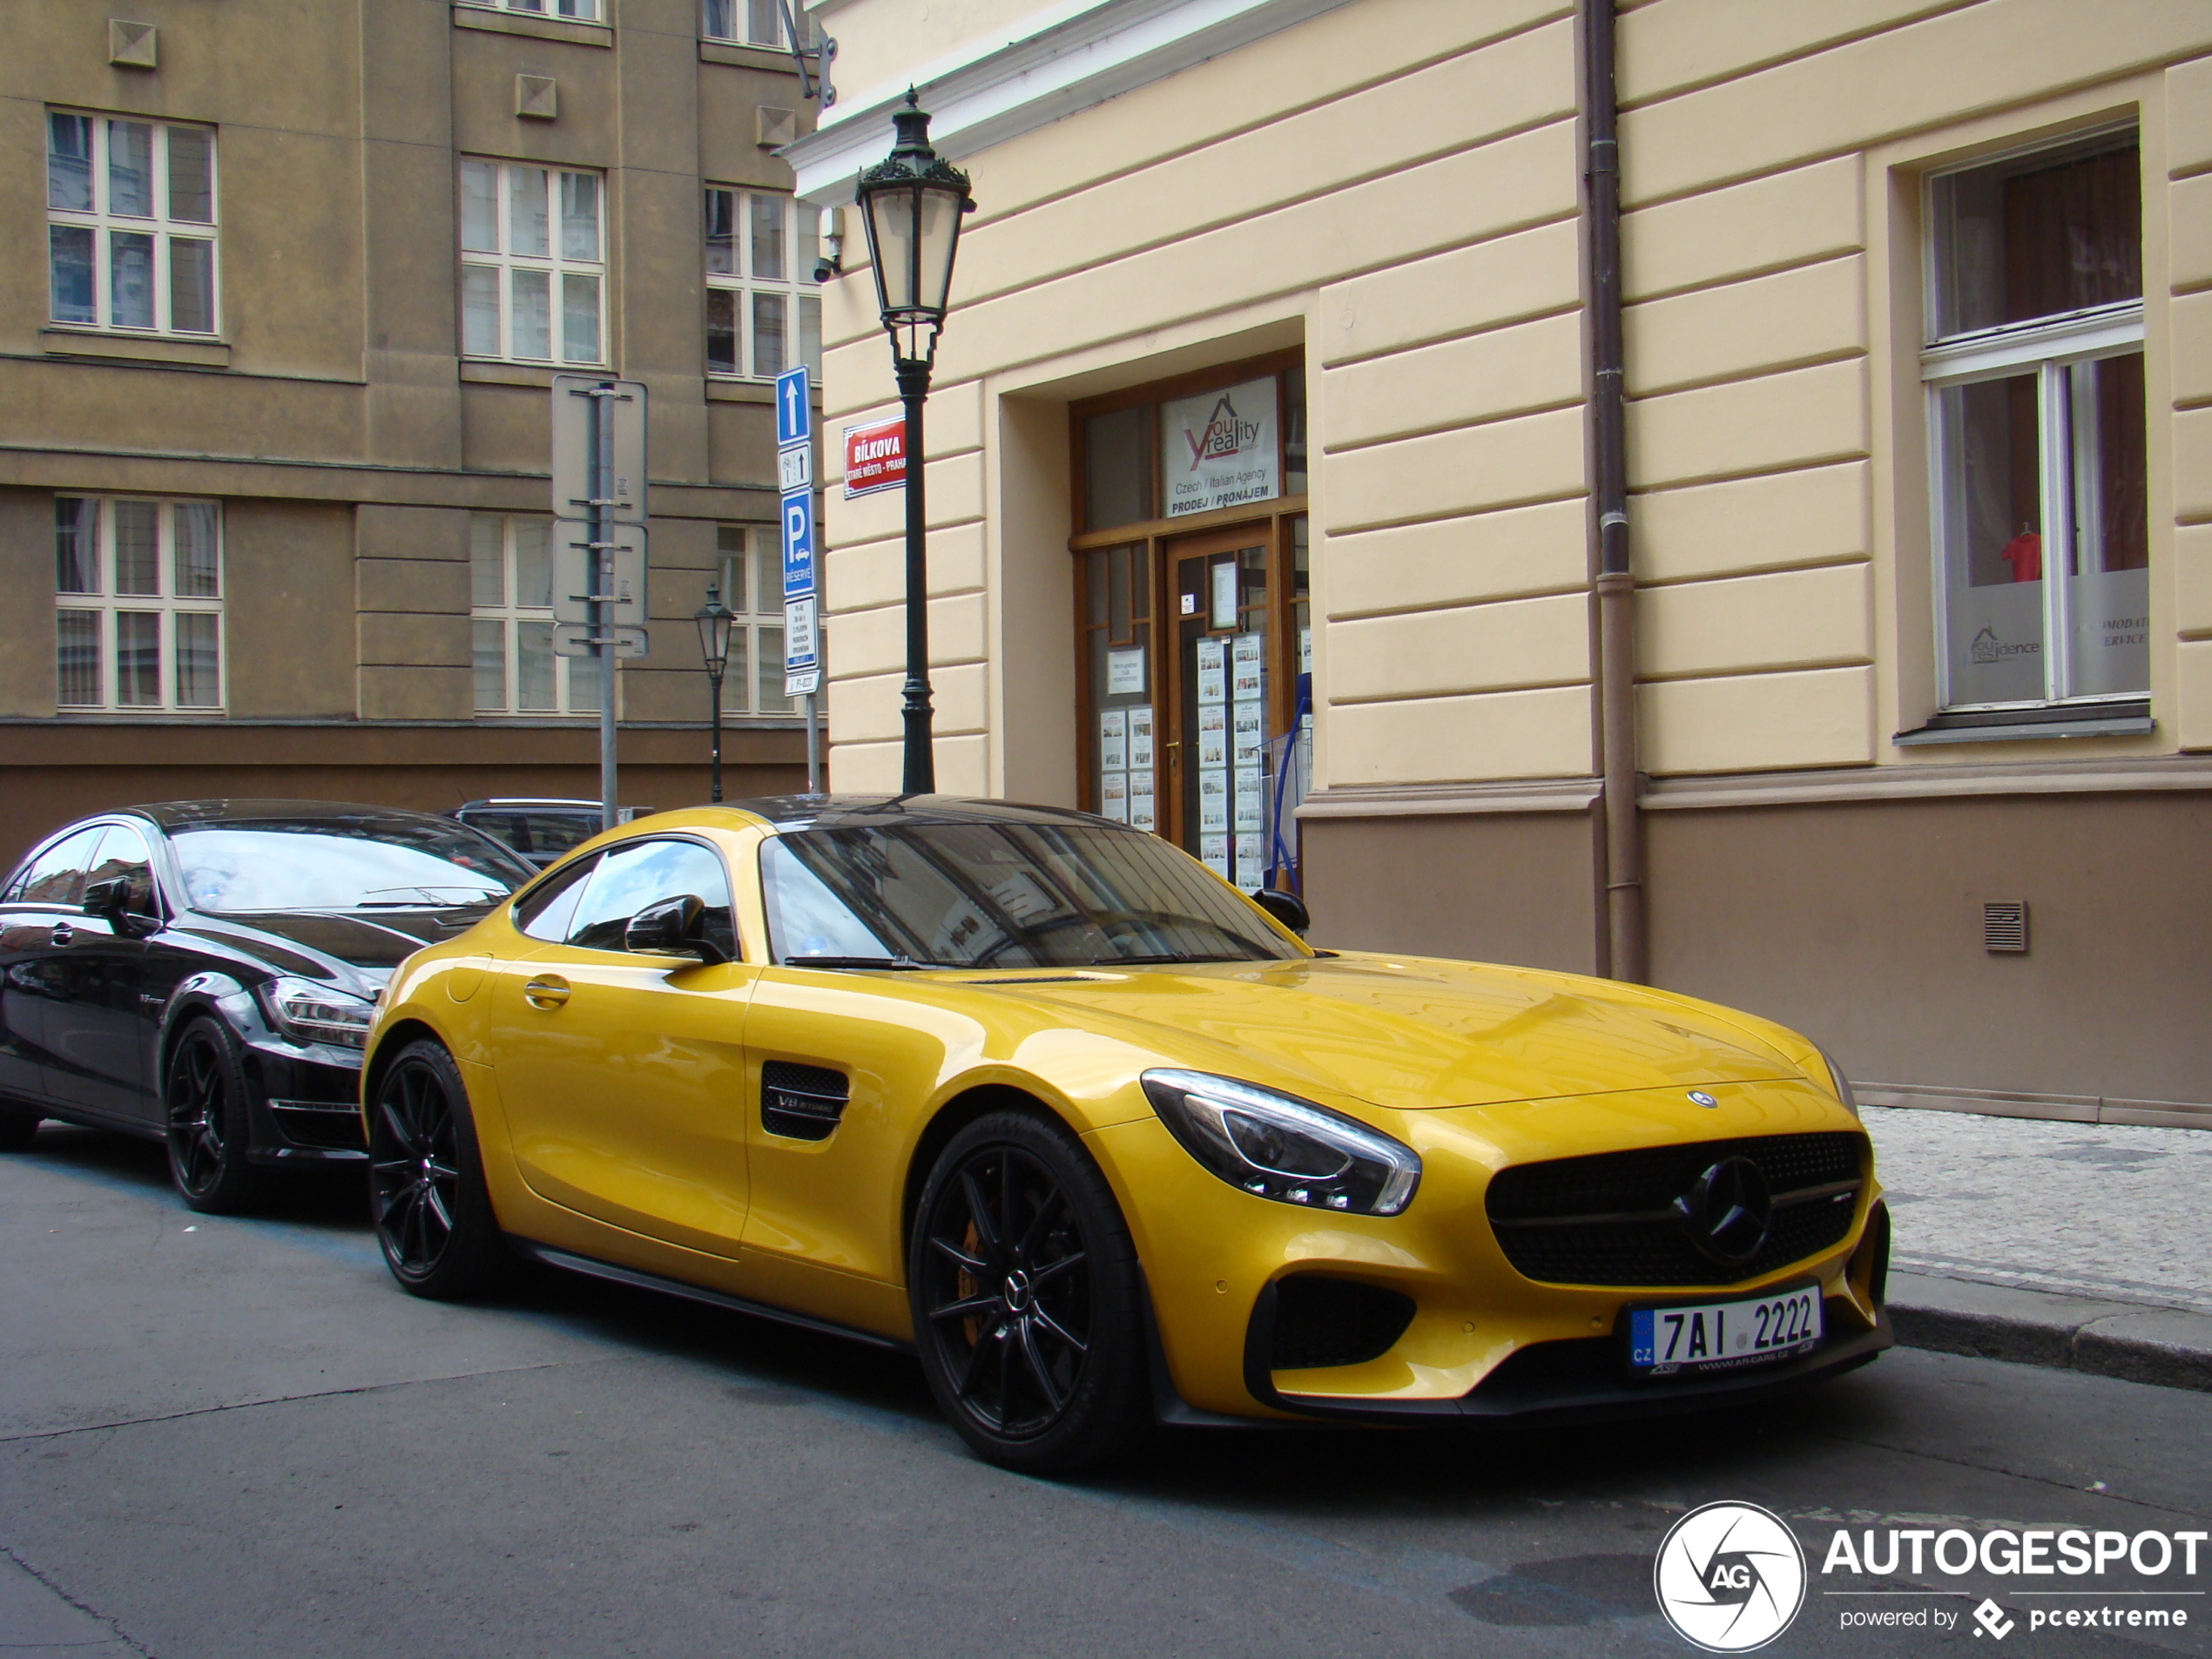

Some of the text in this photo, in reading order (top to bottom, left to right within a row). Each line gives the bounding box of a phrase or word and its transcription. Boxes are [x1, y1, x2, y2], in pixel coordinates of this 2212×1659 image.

[854, 436, 900, 463] BÍLKOVA
[847, 466, 863, 482] STARÉ
[863, 462, 882, 478] MĚSTO
[1176, 480, 1202, 495] Czech
[1210, 475, 1234, 488] Italian
[1236, 469, 1266, 484] Agency
[1172, 497, 1209, 514] PRODEJ
[1217, 486, 1269, 505] PRONÁJEM
[788, 506, 806, 563] P
[786, 564, 812, 583] RÉSERVÉ
[2102, 634, 2146, 647] ERVICE
[1664, 1294, 1811, 1359] 7AI 2222
[1634, 1348, 1651, 1362] CZ
